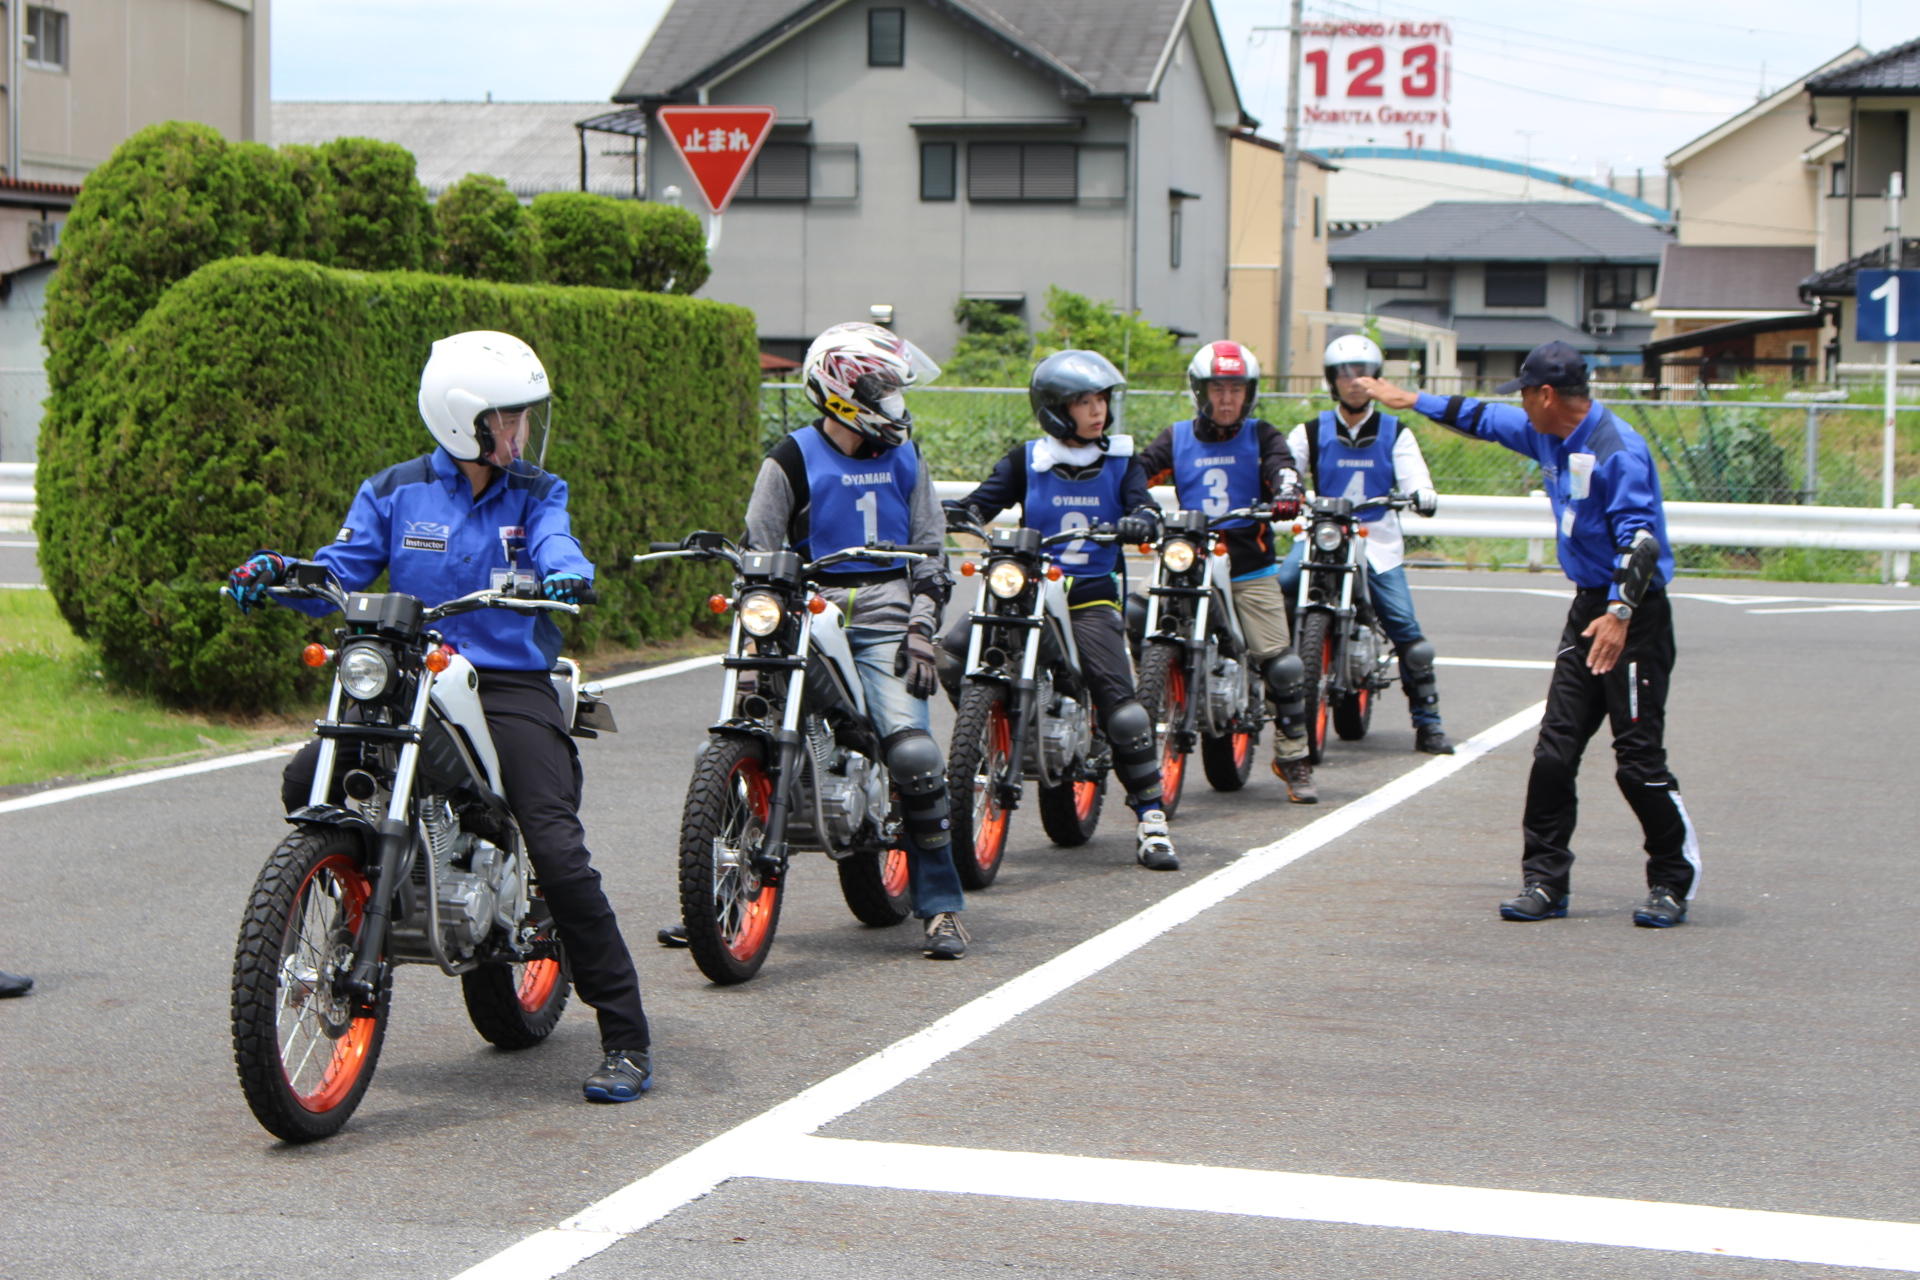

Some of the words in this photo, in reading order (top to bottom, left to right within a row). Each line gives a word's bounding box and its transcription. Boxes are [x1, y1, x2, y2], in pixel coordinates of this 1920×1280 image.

[683, 127, 751, 152] 止まれ
[1870, 275, 1900, 337] 1
[851, 472, 892, 485] YAMAHA
[1202, 468, 1230, 517] 3
[1342, 470, 1367, 509] 4
[856, 491, 878, 545] 1
[1062, 496, 1100, 506] YAMAHA
[405, 538, 445, 550] Instructor
[1061, 512, 1089, 564] 2
